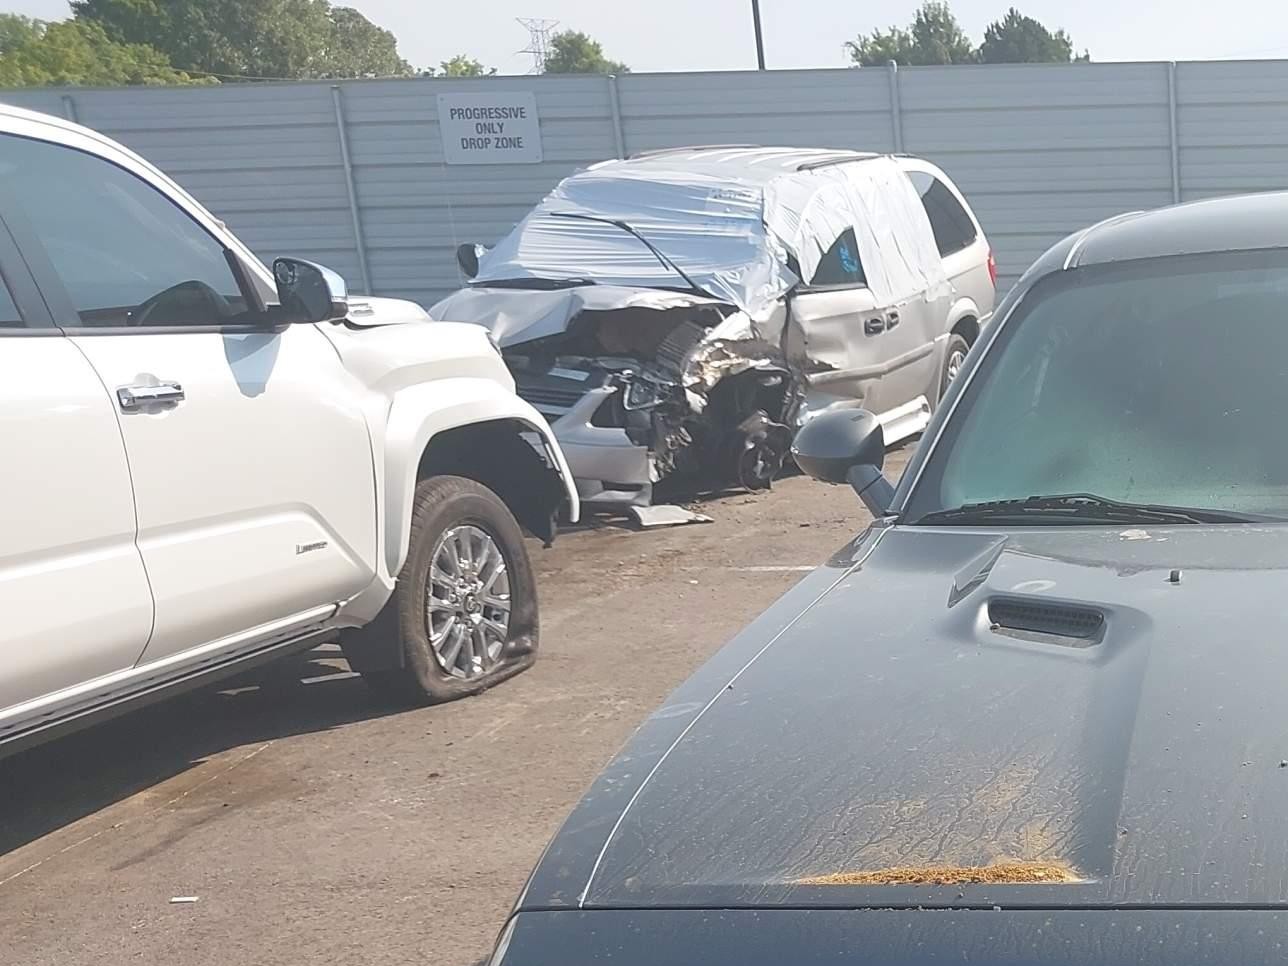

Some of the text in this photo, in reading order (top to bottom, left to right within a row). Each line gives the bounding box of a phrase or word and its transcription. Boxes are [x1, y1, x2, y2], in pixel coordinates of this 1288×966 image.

[450, 107, 527, 120] PROGRESSIVE
[475, 122, 504, 135] ONLY
[460, 136, 524, 150] DROP ZONE
